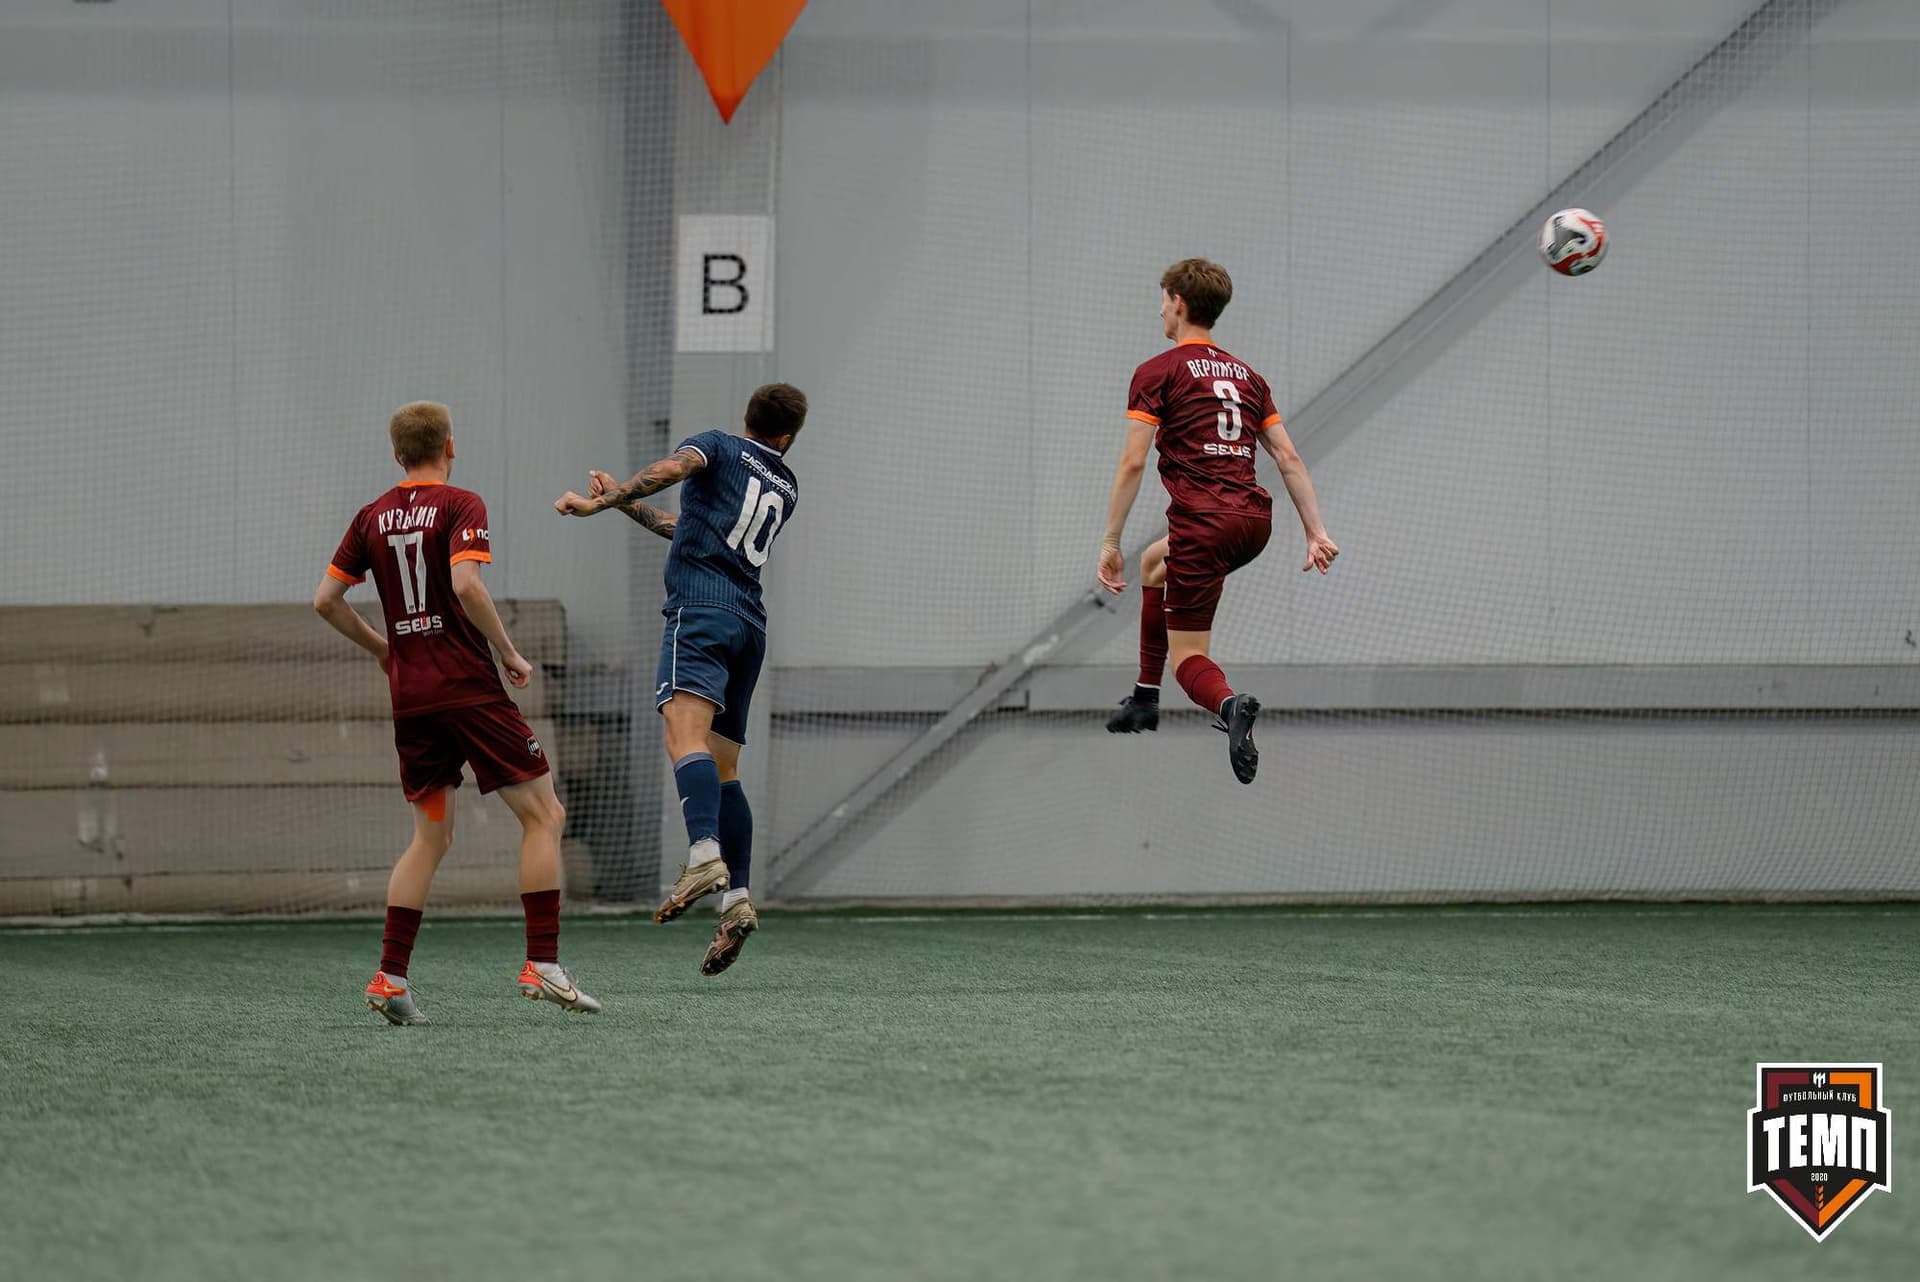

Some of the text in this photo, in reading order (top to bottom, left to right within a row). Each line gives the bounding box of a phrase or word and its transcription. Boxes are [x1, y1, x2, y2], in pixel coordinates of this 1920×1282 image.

[1213, 380, 1242, 441] 3
[1203, 443, 1252, 459] SEUS
[726, 476, 785, 567] 10
[387, 530, 427, 615] 17
[395, 615, 443, 636] SEUS
